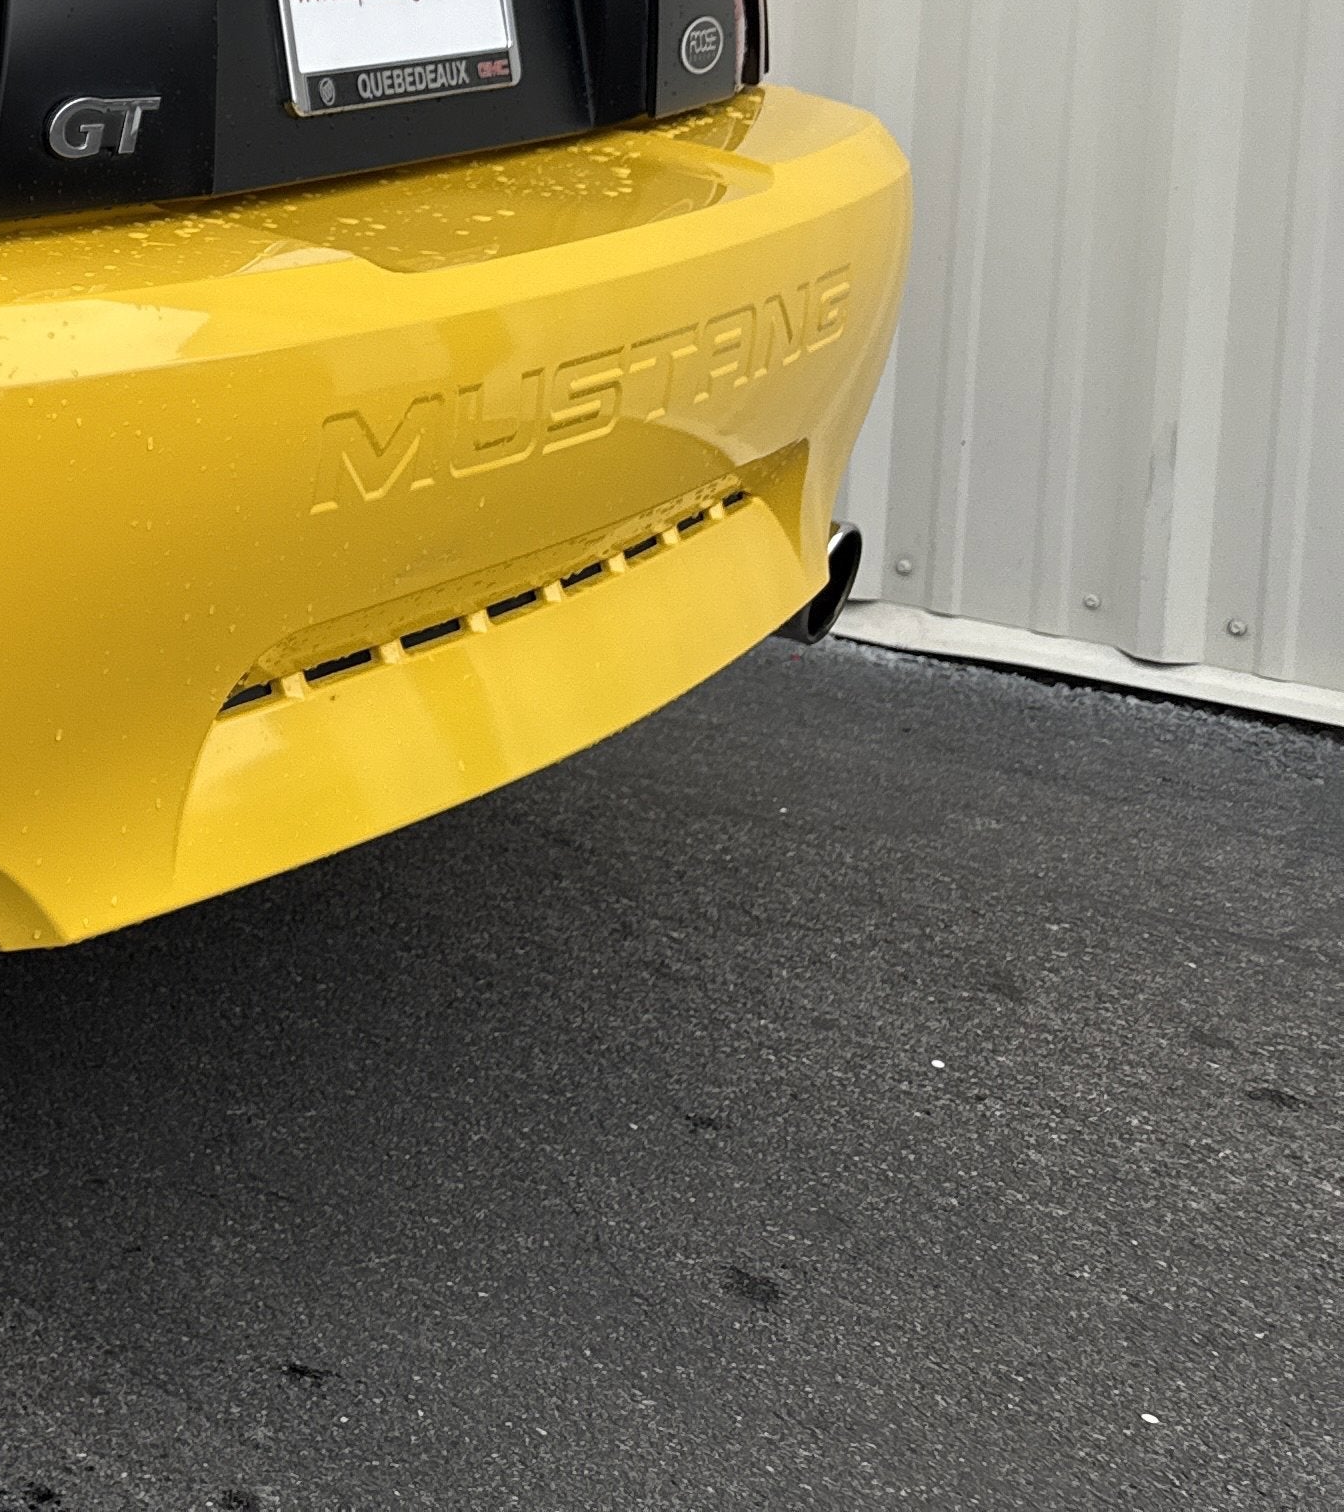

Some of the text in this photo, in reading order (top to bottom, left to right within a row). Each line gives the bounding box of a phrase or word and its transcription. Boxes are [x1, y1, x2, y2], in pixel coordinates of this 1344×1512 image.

[357, 59, 510, 100] QUEBEDEAUX GMC
[49, 96, 162, 159] GT
[310, 262, 852, 515] MUSTANG
